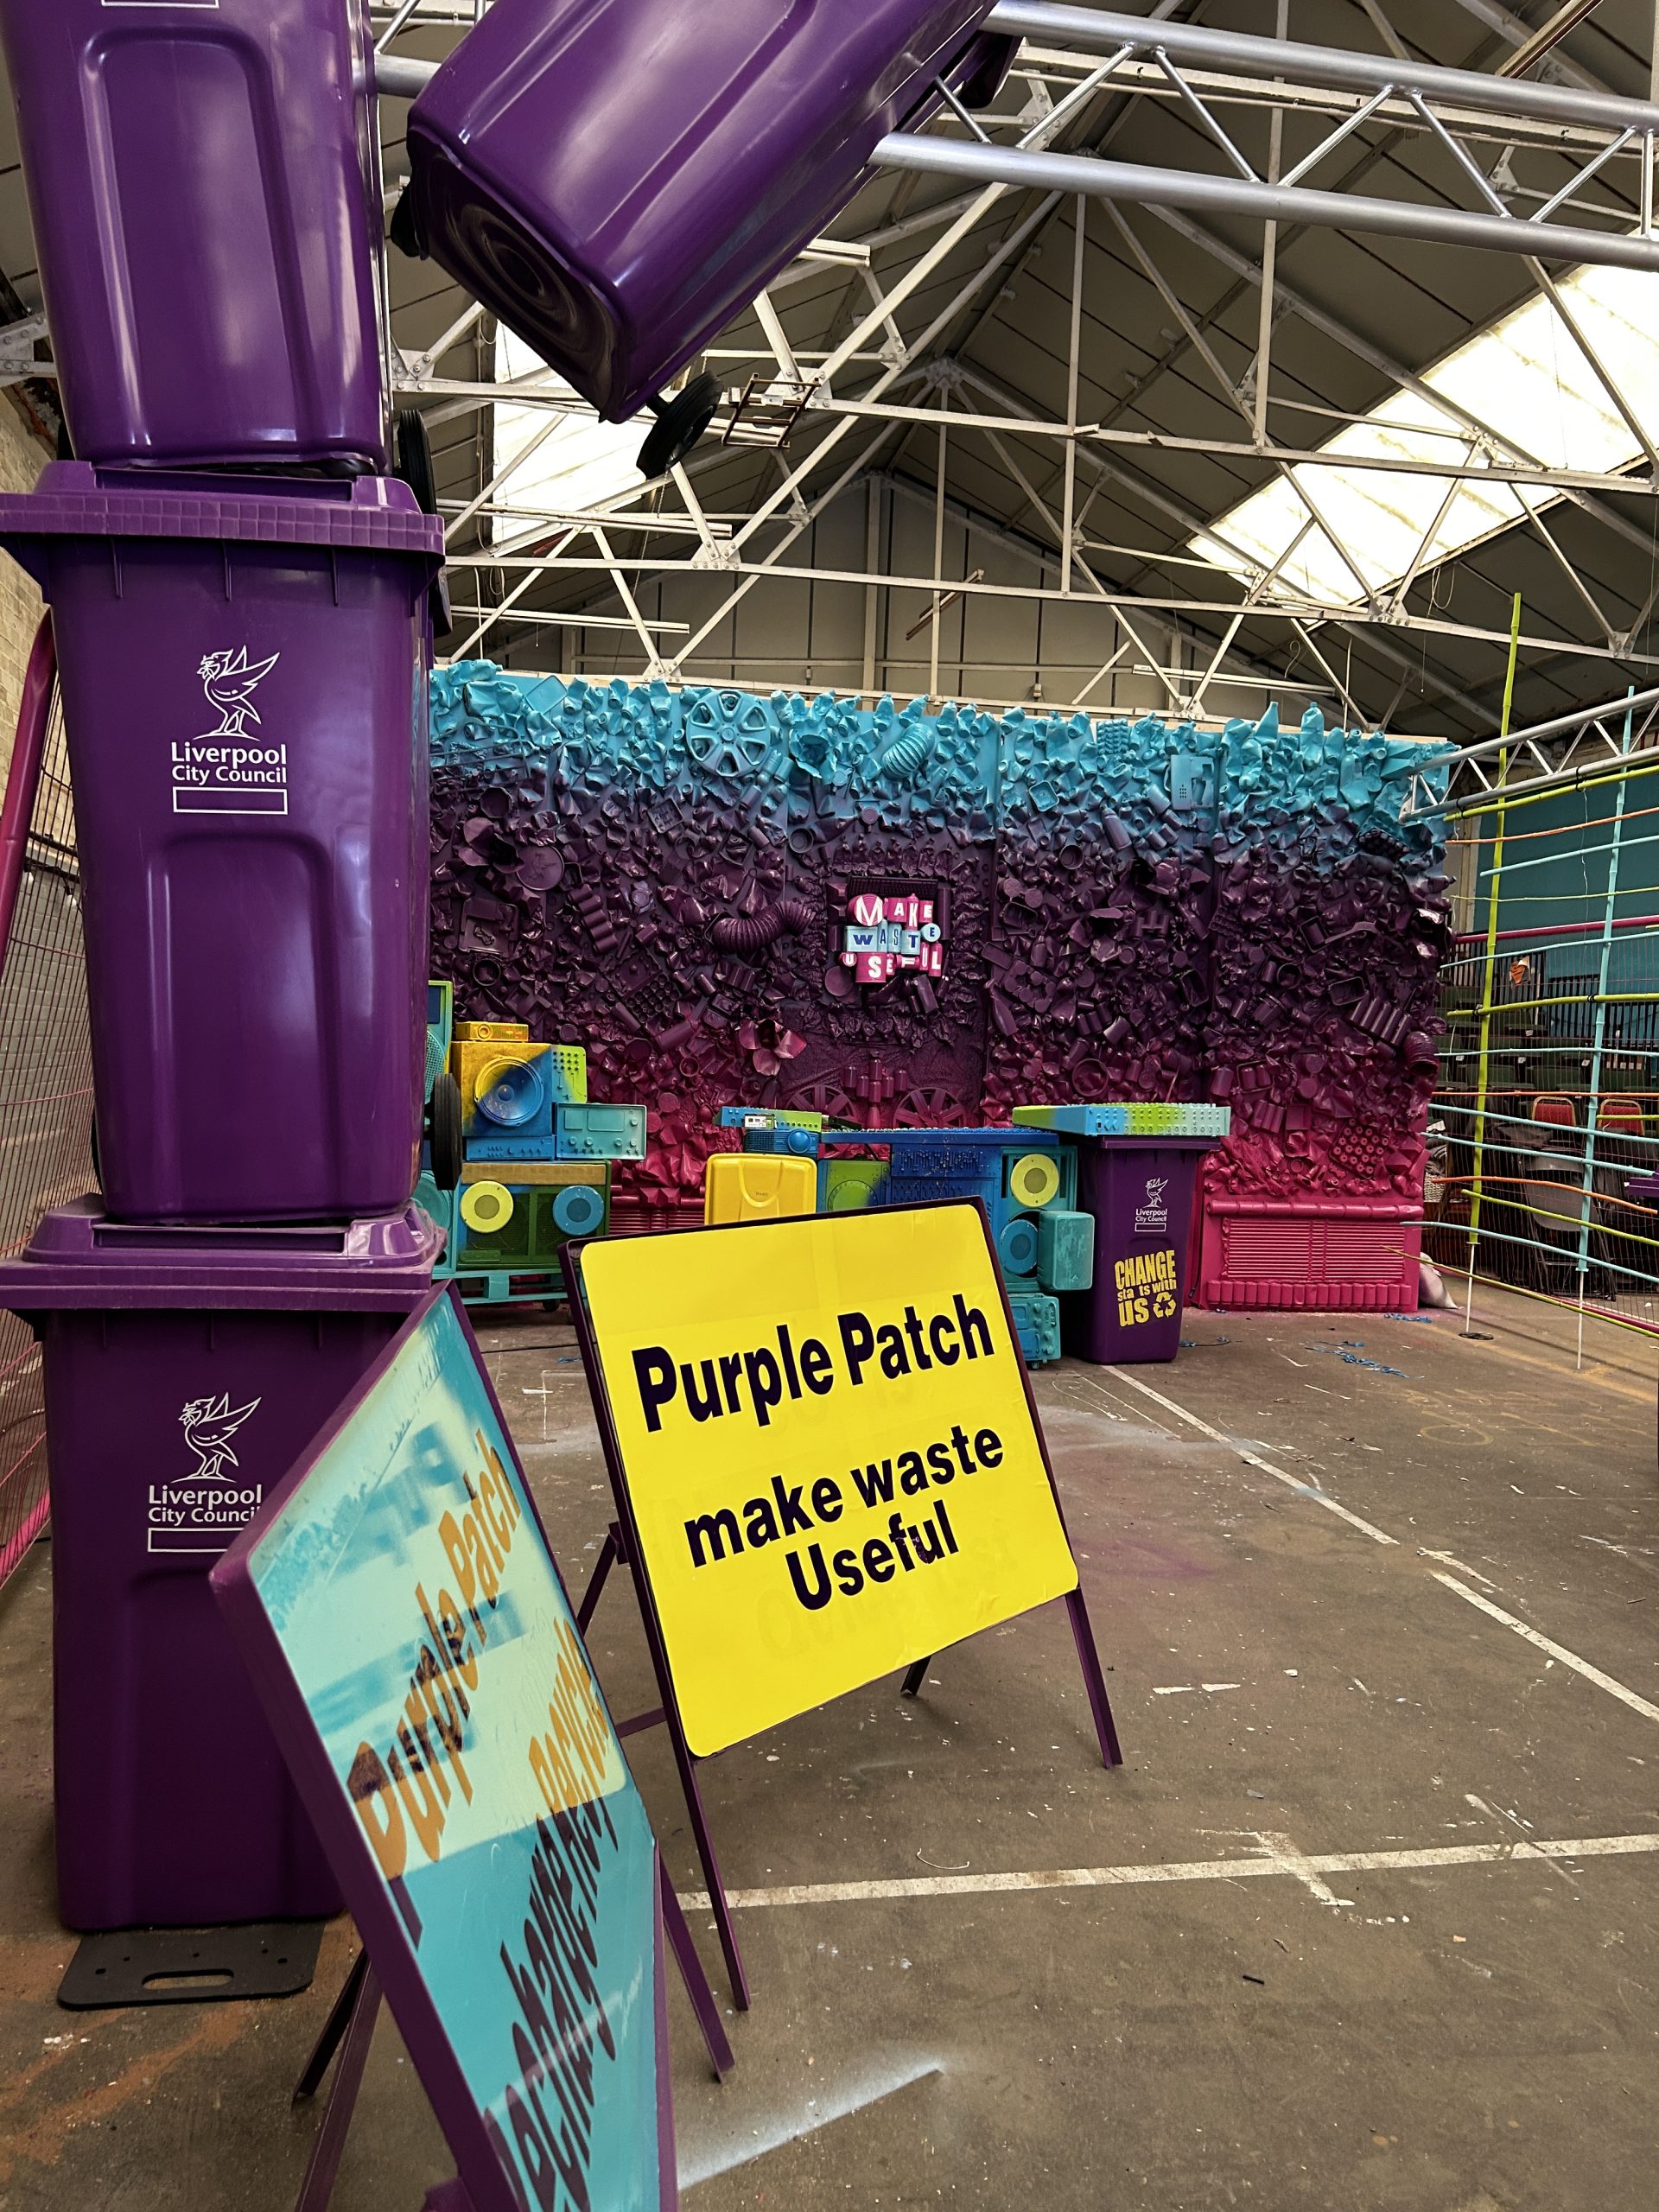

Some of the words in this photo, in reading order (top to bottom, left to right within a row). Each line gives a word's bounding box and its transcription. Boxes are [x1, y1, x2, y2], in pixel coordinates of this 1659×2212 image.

[171, 741, 287, 769] Liverpool
[172, 765, 210, 785] City
[216, 766, 287, 783] Council
[855, 895, 933, 927] MAKE
[852, 926, 935, 949] WASTE
[845, 947, 941, 978] USEFUL
[1135, 1208, 1168, 1217] Liverpool
[1114, 1249, 1176, 1290] CHANGE
[1152, 1278, 1177, 1294] with
[632, 1324, 834, 1433] Purple
[837, 1293, 995, 1386] Patch
[149, 1484, 262, 1510] Liverpool
[683, 1475, 844, 1567] make
[849, 1425, 1004, 1509] waste
[148, 1507, 186, 1526] City
[191, 1506, 260, 1522] Counci
[785, 1500, 960, 1611] Useful
[346, 1582, 479, 1950] Purple
[438, 1427, 520, 1647] Patch
[529, 1617, 618, 1924] Recycle
[484, 1812, 616, 2212] echarge
